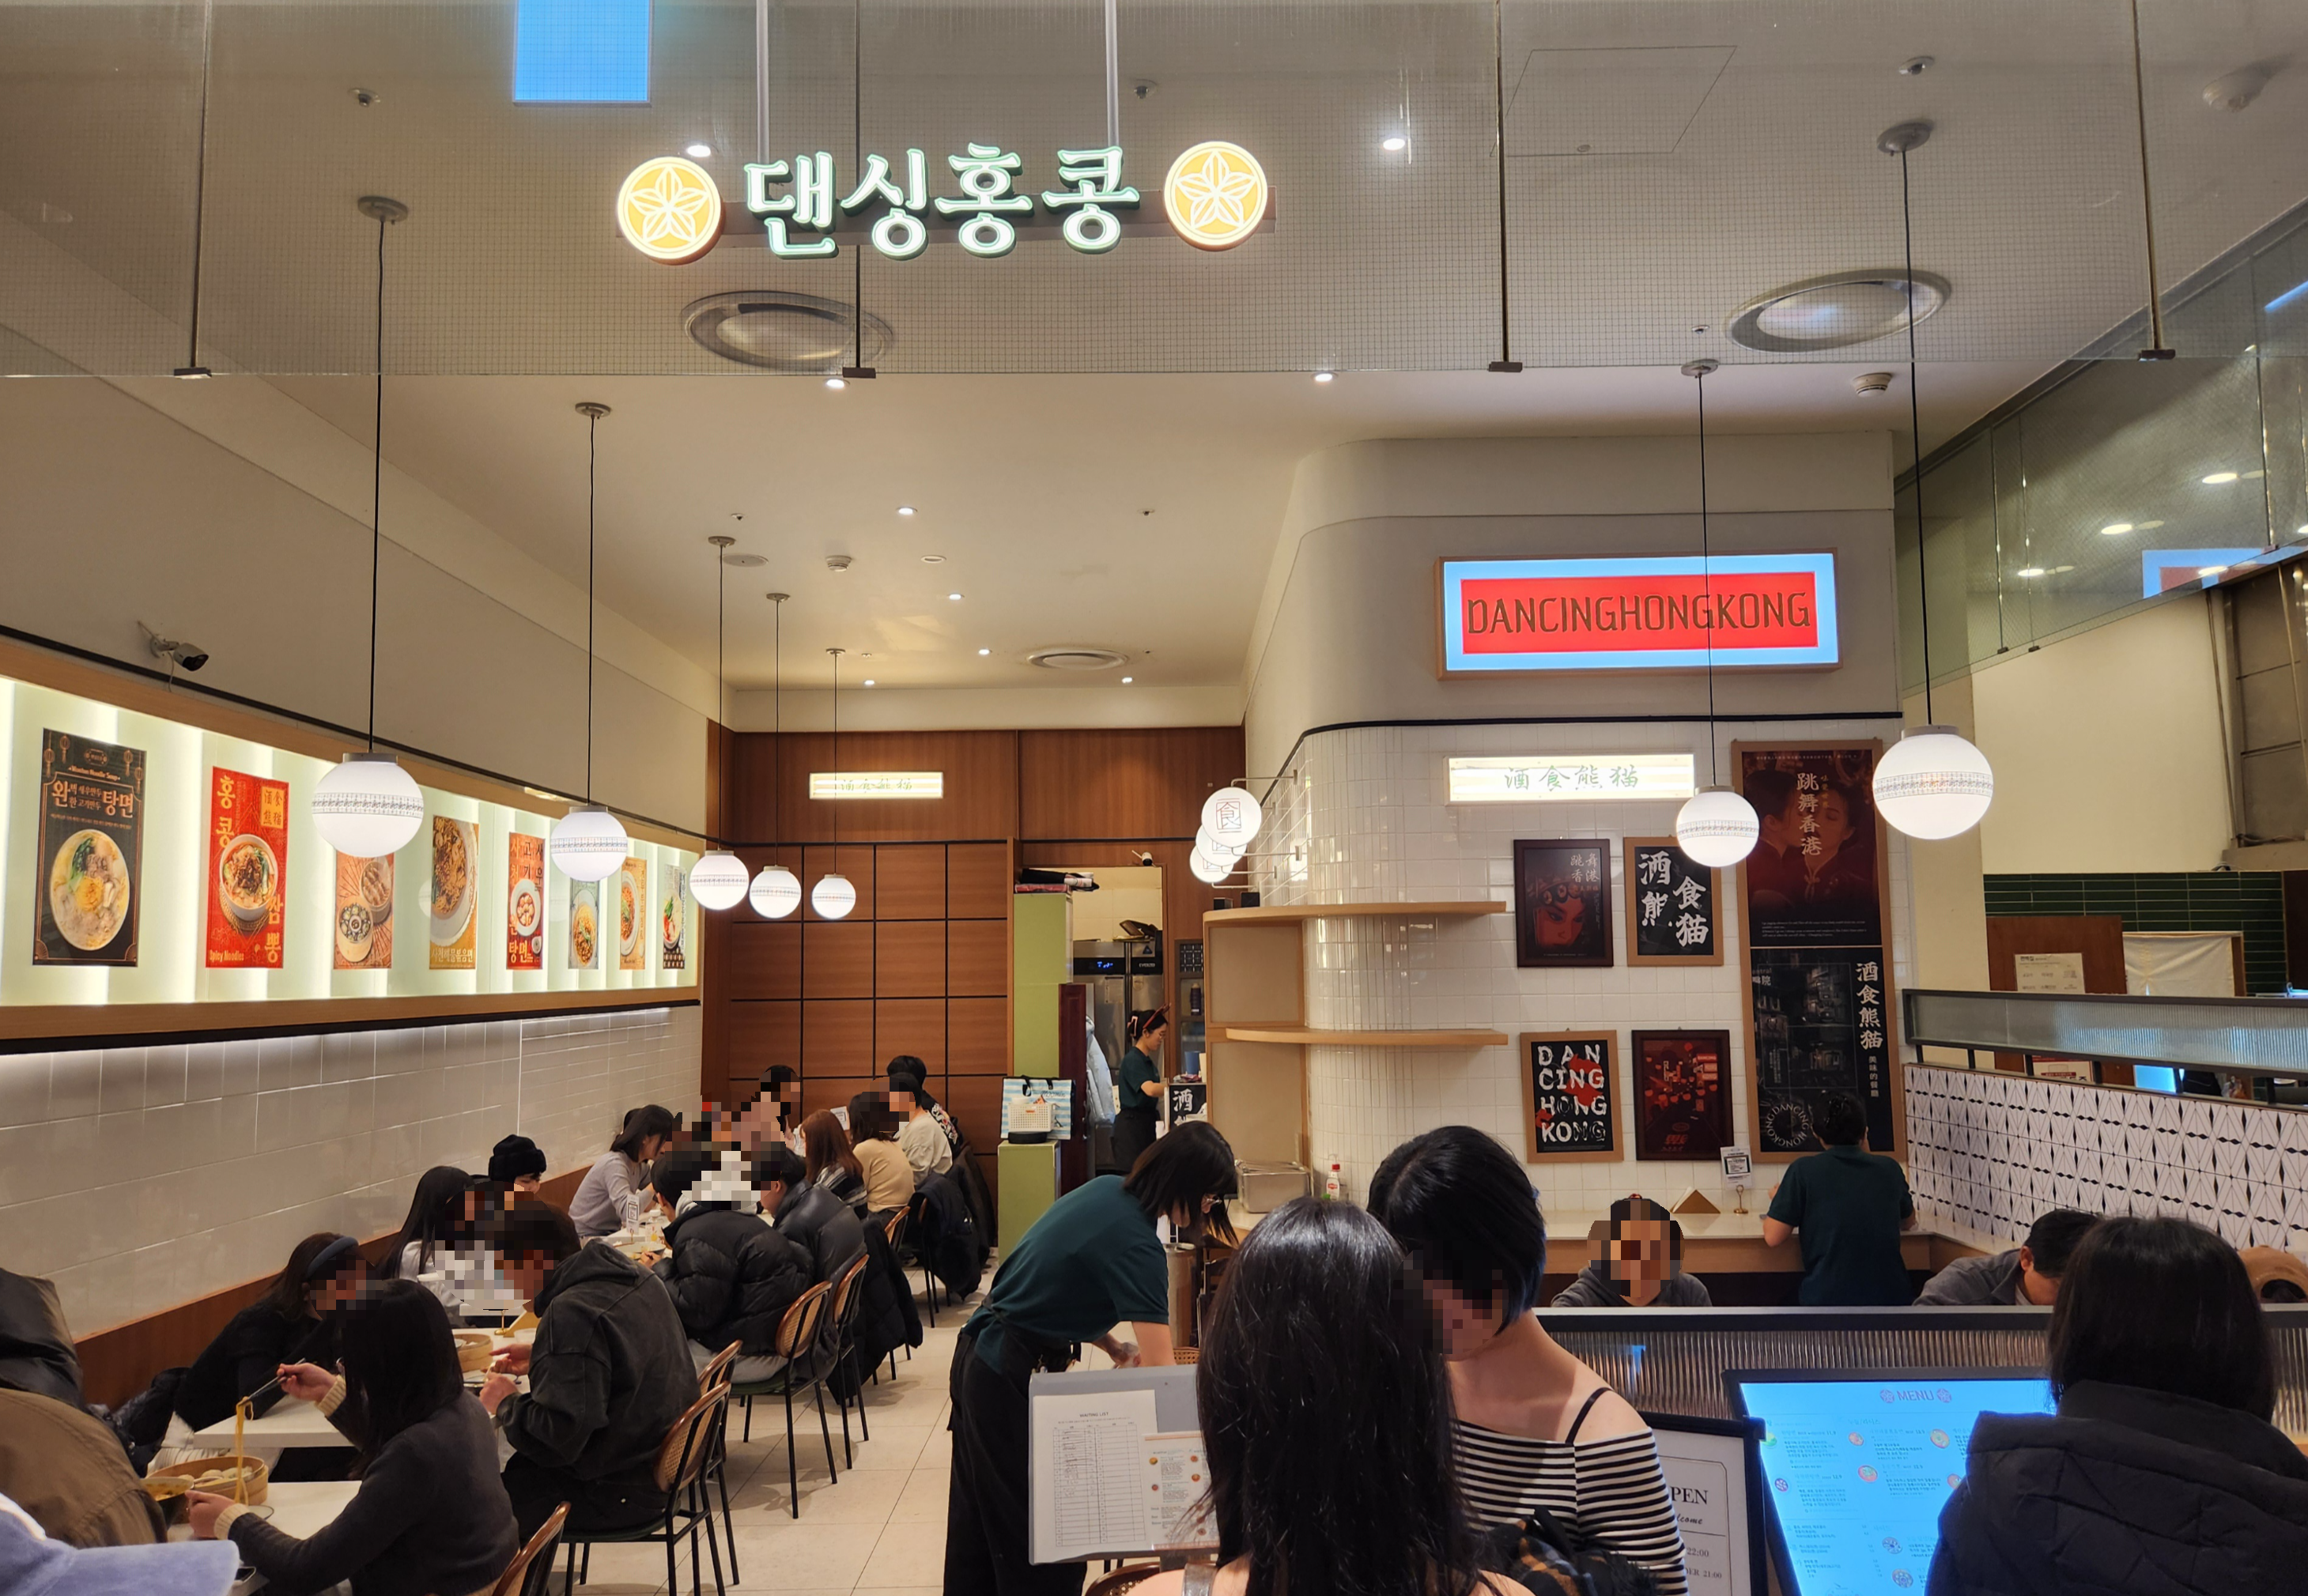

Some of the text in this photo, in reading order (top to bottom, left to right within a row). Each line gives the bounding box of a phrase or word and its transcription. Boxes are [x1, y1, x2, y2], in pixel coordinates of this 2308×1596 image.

[742, 141, 1141, 259] 댄싱홍콩
[1467, 591, 1812, 634] DANCINGHONGKONG
[1504, 764, 1639, 792] 酒食熊猫
[216, 775, 236, 848] 홍콩
[1796, 772, 1823, 856] 跳舞香港
[265, 893, 284, 964] 짬뽕
[1856, 961, 1883, 1051] 酒食熊猫
[1537, 1043, 1601, 1066] DAN
[1538, 1067, 1605, 1090] CING
[1539, 1095, 1607, 1116] HONG
[1541, 1120, 1606, 1143] KONG
[1896, 1389, 1935, 1402] MENU
[1670, 1486, 1709, 1505] PEN
[1676, 1514, 1703, 1526] lcome
[1687, 1547, 1709, 1557] 22:00
[1702, 1570, 1722, 1579] 21:00
